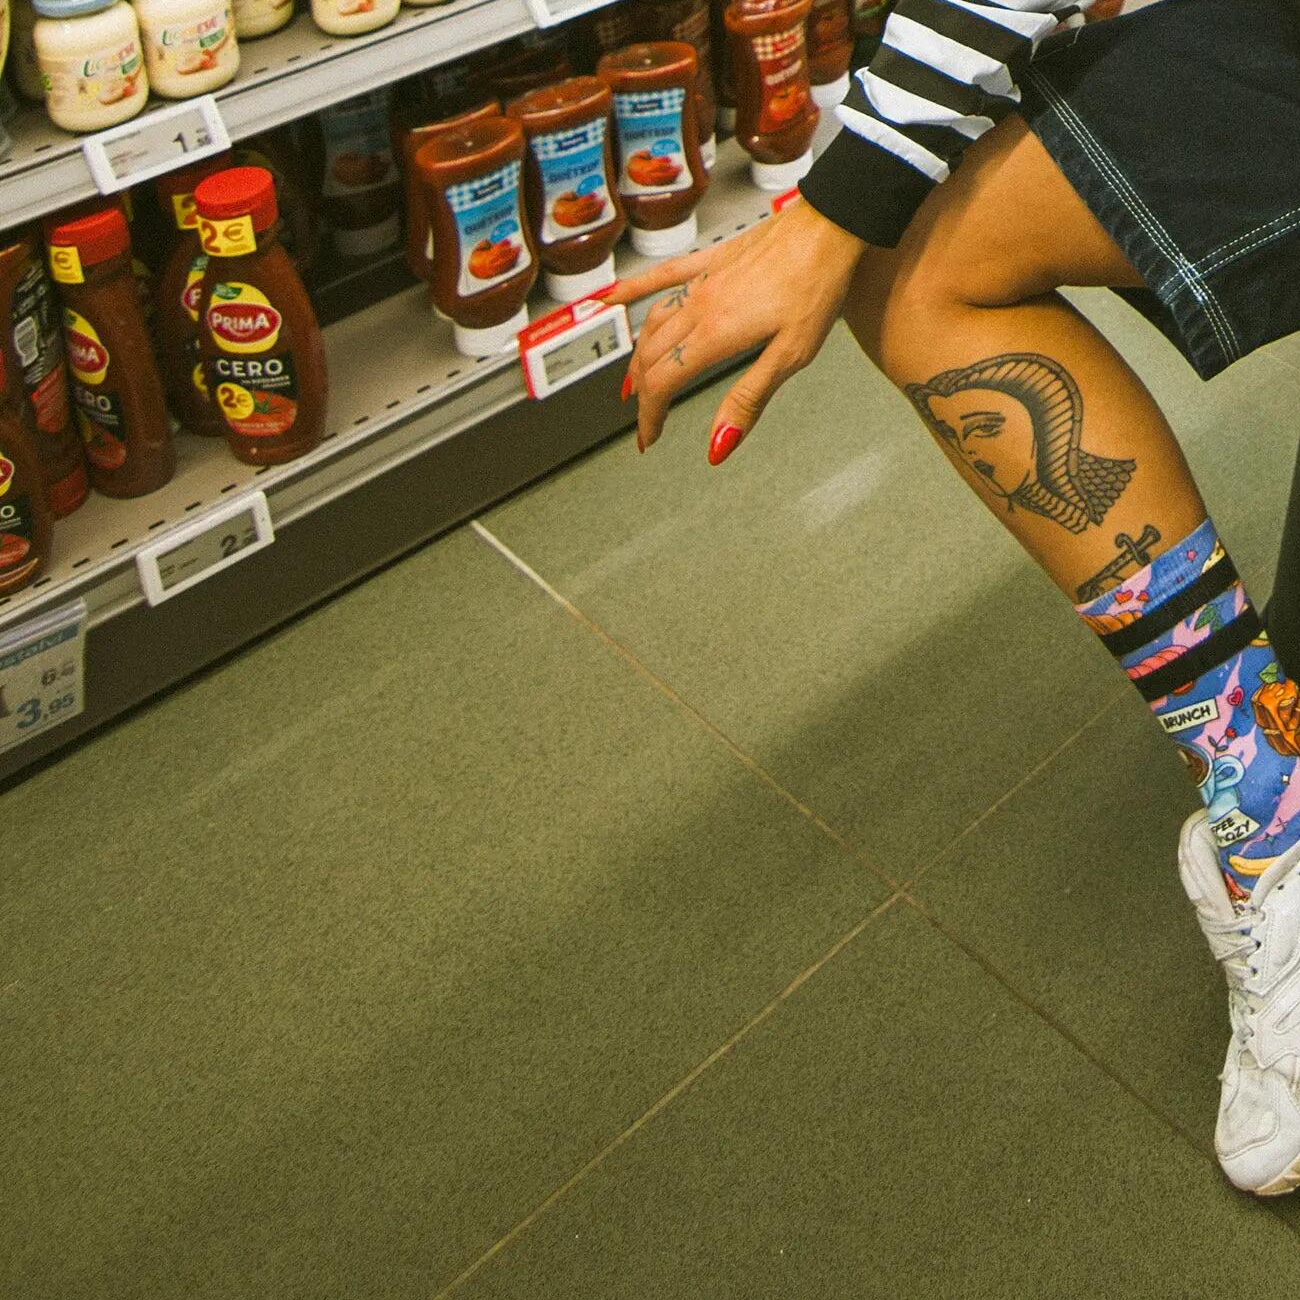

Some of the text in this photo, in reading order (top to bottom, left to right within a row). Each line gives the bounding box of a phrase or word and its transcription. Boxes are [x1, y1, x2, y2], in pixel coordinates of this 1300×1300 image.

[211, 311, 271, 338] PRIMA
[216, 358, 284, 379] CERO
[220, 386, 250, 409] 2€
[1209, 816, 1234, 834] FFEE
[1219, 819, 1251, 844] OZY
